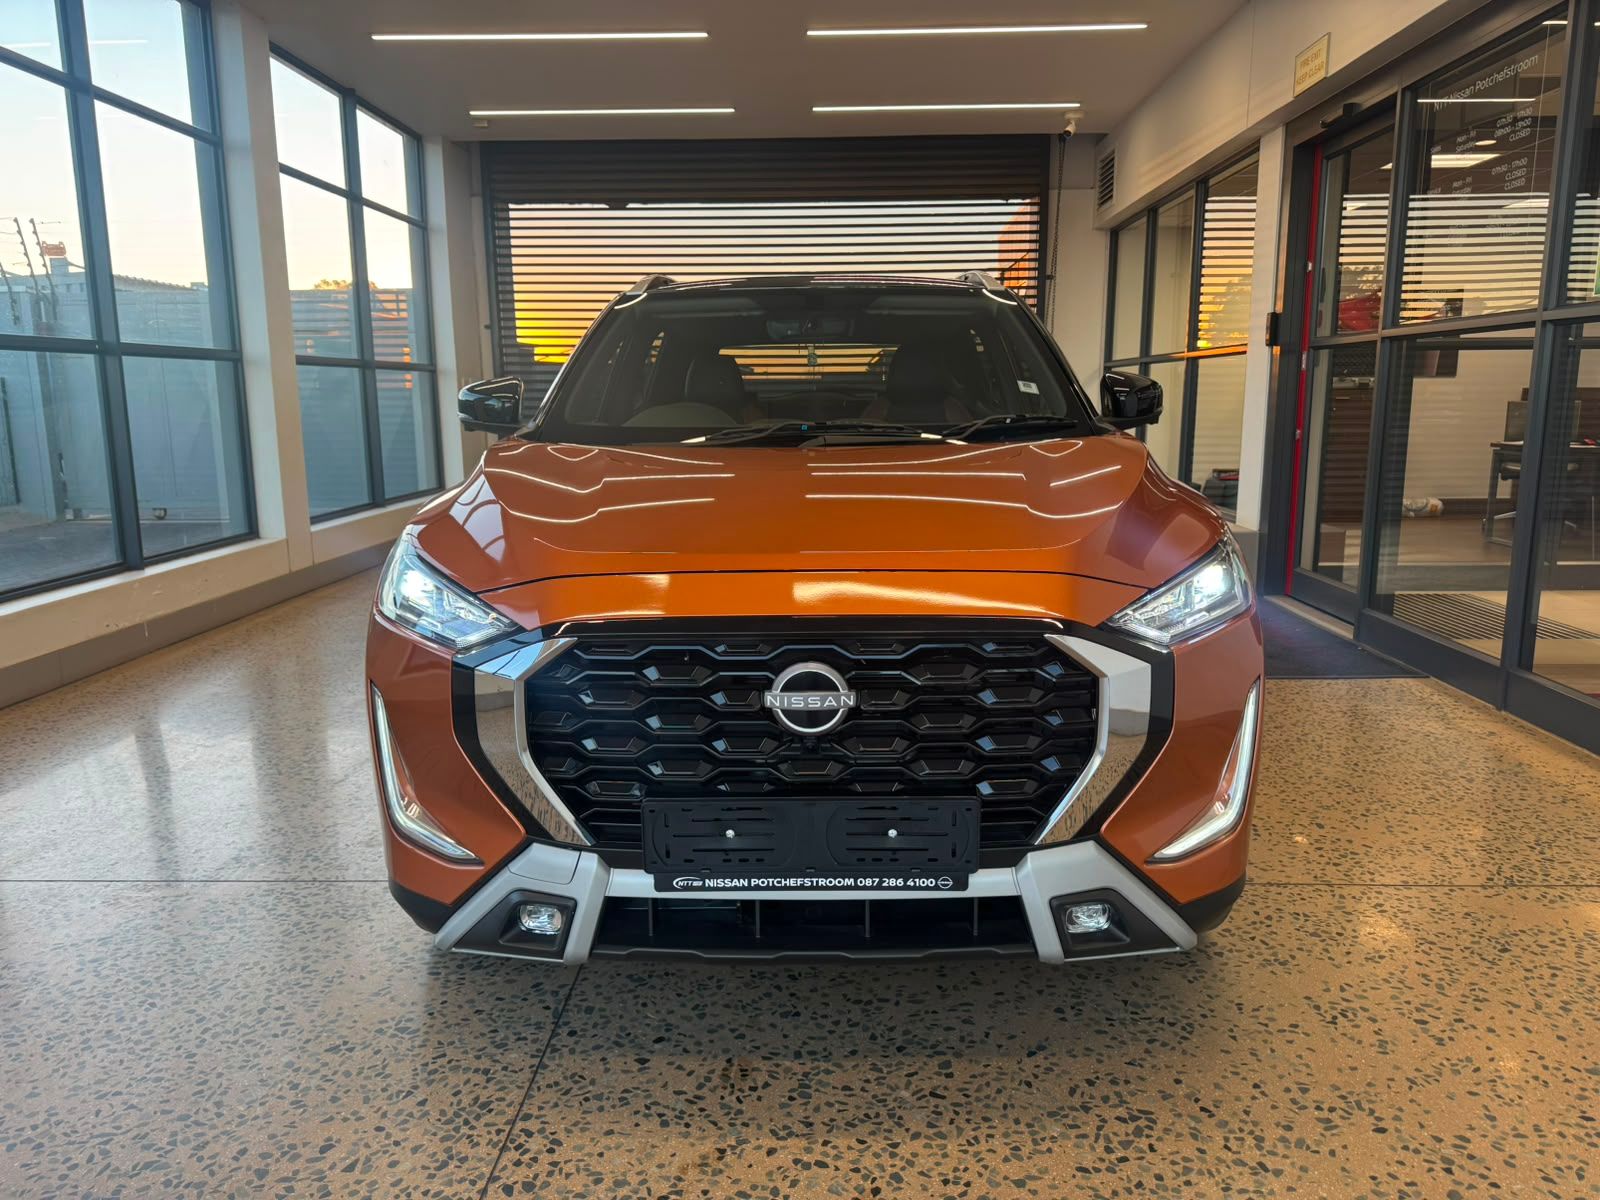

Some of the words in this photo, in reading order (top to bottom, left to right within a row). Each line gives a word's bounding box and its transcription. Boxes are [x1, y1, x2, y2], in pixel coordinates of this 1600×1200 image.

[1475, 55, 1538, 92] Potchefstroom
[1509, 128, 1531, 141] CLOSED
[1505, 168, 1527, 180] CLOSED
[1504, 177, 1526, 190] CLOSED
[767, 695, 854, 708] NISSAN
[705, 878, 748, 887] NISSAN
[751, 878, 855, 887] POTCHEFSTROOM
[857, 878, 880, 887] 087
[882, 878, 904, 887] 286
[906, 878, 936, 887] 4100
